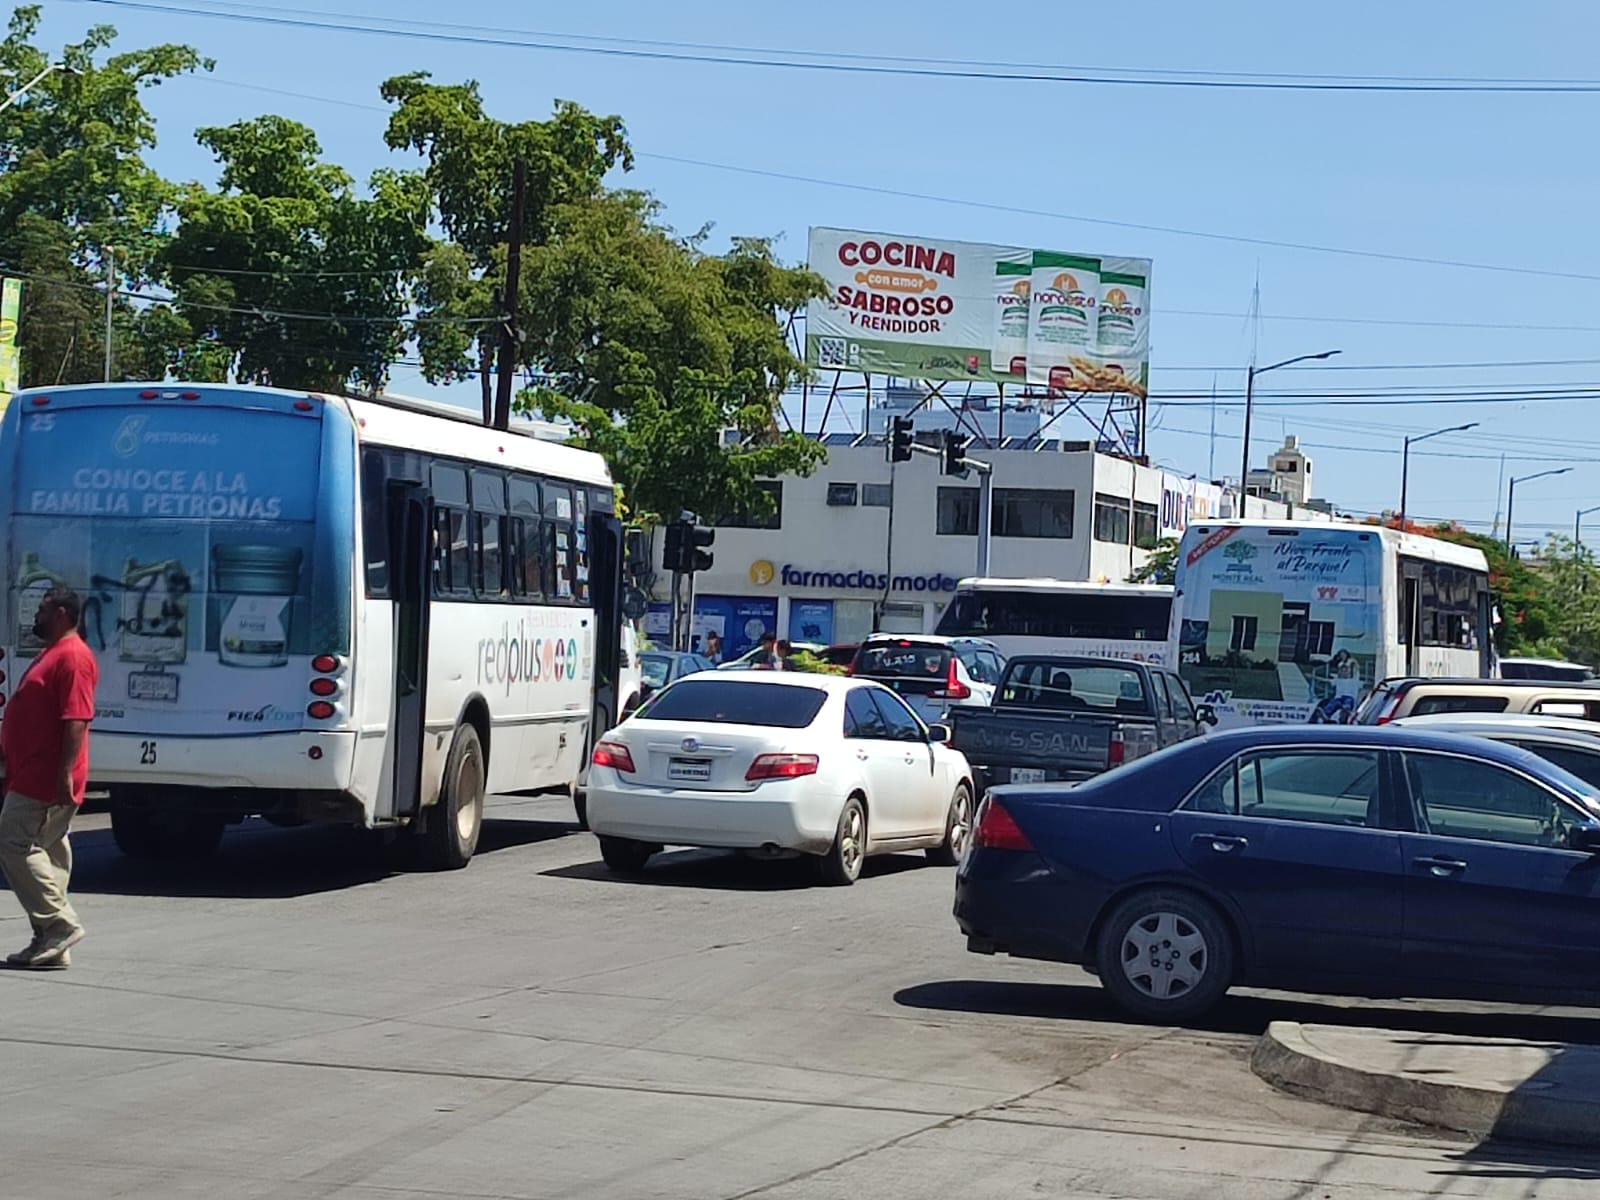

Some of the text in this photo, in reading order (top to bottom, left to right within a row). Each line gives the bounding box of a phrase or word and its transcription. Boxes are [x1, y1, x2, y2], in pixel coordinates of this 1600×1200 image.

[838, 241, 955, 279] COCINA
[868, 273, 924, 289] con amor
[838, 286, 954, 317] SABROSO
[849, 311, 941, 334] Y RENDIDOR
[30, 413, 56, 431] 25
[73, 468, 248, 493] CONOCE A LA
[30, 490, 282, 519] FAMILIA PETRONAS
[477, 618, 543, 697] redplus
[140, 741, 157, 764] 25
